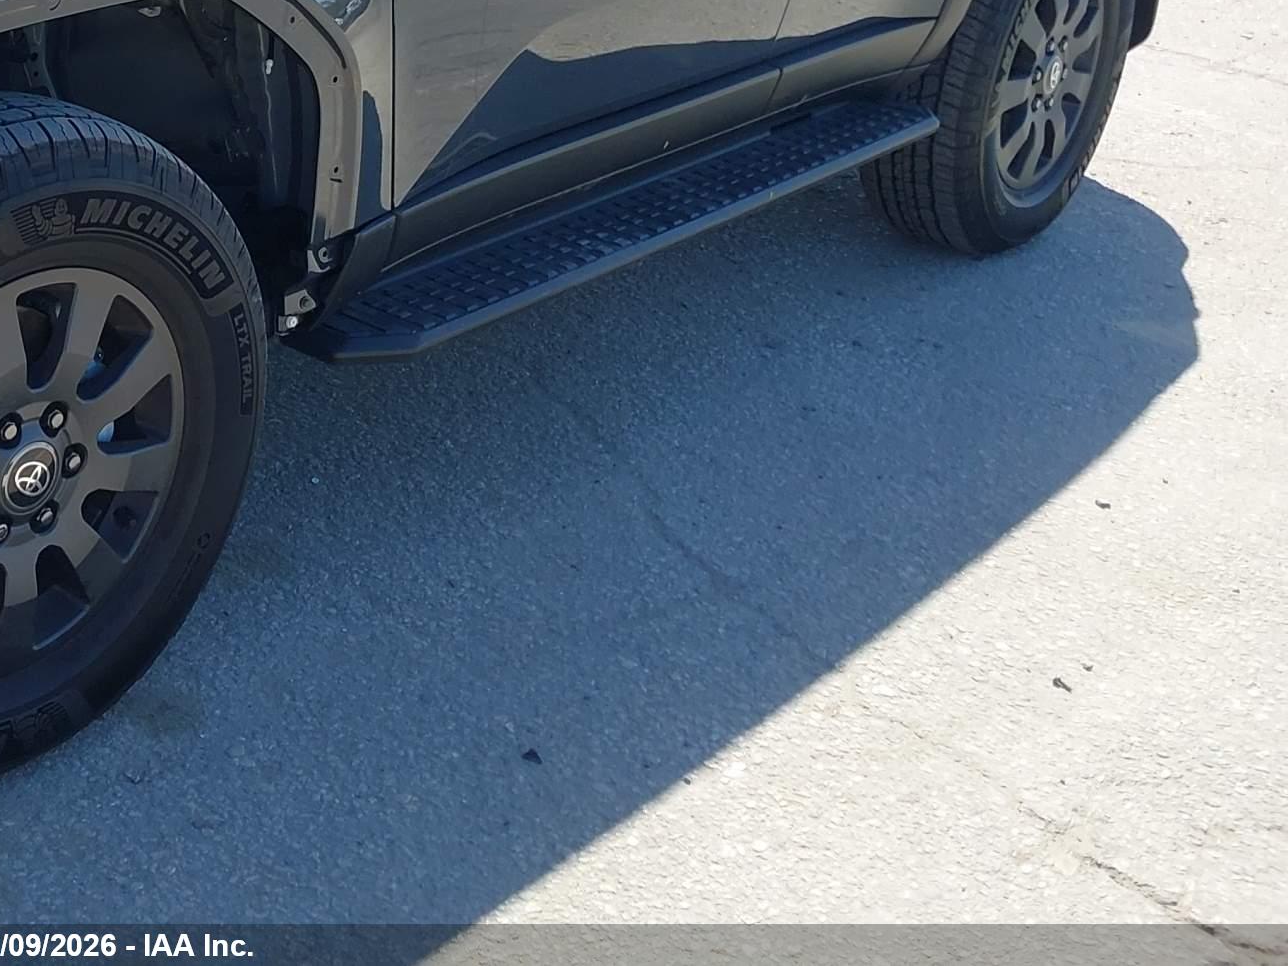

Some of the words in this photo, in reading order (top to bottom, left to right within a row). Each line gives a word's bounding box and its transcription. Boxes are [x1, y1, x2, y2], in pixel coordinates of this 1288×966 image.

[79, 197, 226, 290] MICHELIN
[233, 313, 250, 348] LTX
[241, 351, 253, 404] TRAIL
